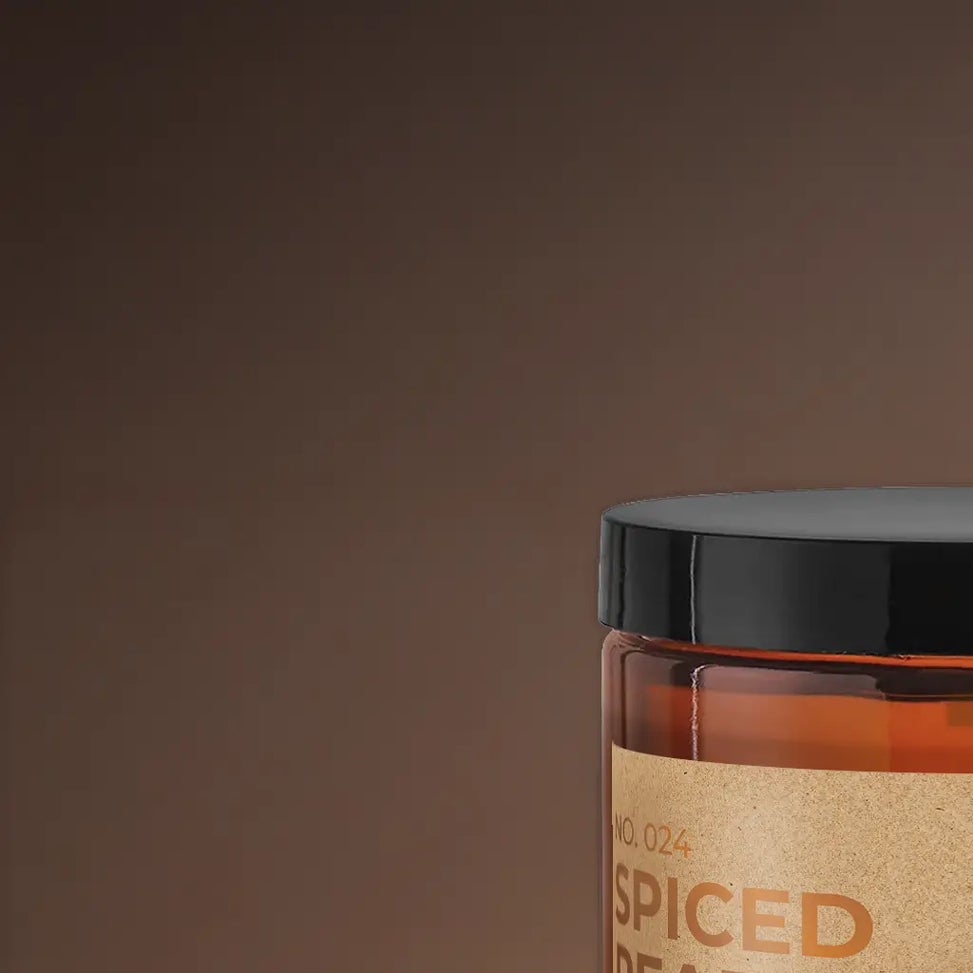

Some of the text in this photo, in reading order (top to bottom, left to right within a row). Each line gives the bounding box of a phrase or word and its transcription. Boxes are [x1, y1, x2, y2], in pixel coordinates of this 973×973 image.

[615, 812, 692, 858] NO. 024
[615, 862, 874, 960] SPICED
